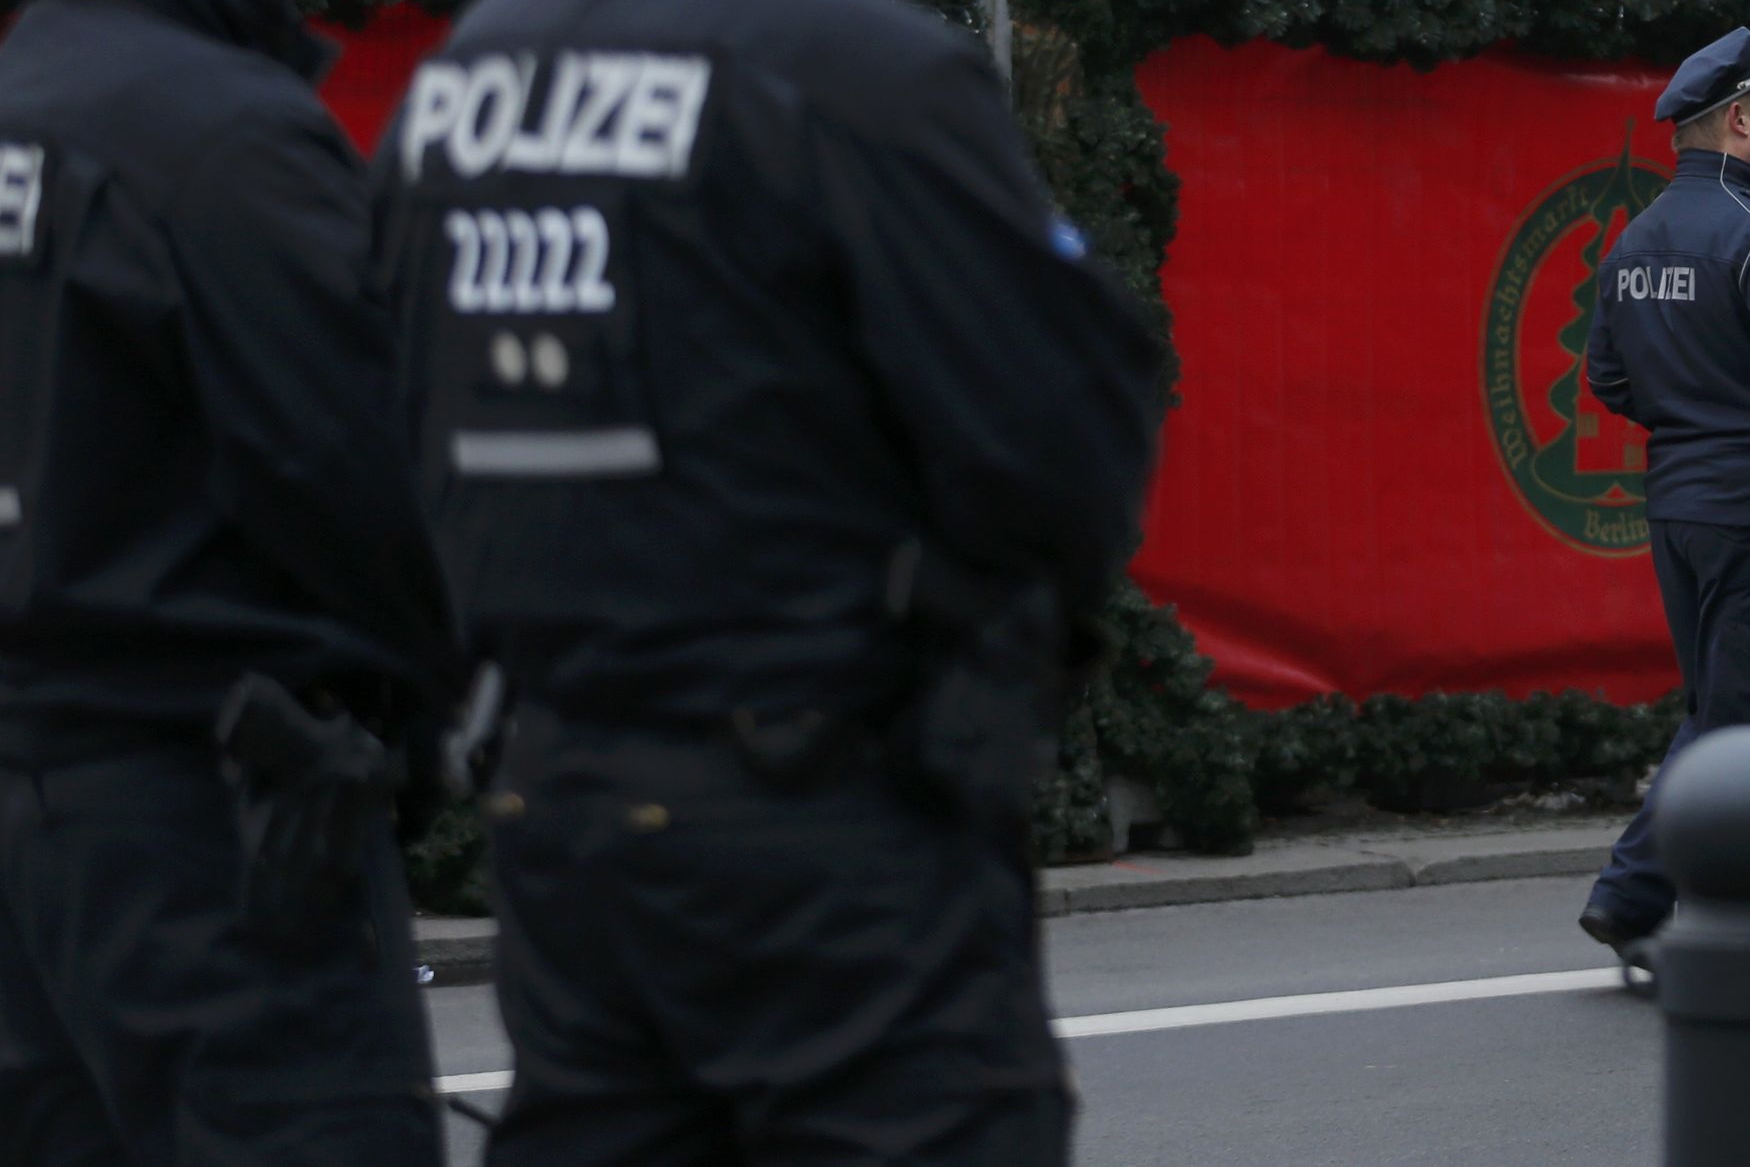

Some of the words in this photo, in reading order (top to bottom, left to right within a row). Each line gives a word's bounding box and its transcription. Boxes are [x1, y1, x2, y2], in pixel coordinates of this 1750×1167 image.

[399, 48, 712, 188] POLIZEI
[1617, 265, 1696, 302] POLIZEI
[1583, 505, 1649, 543] Berlin
